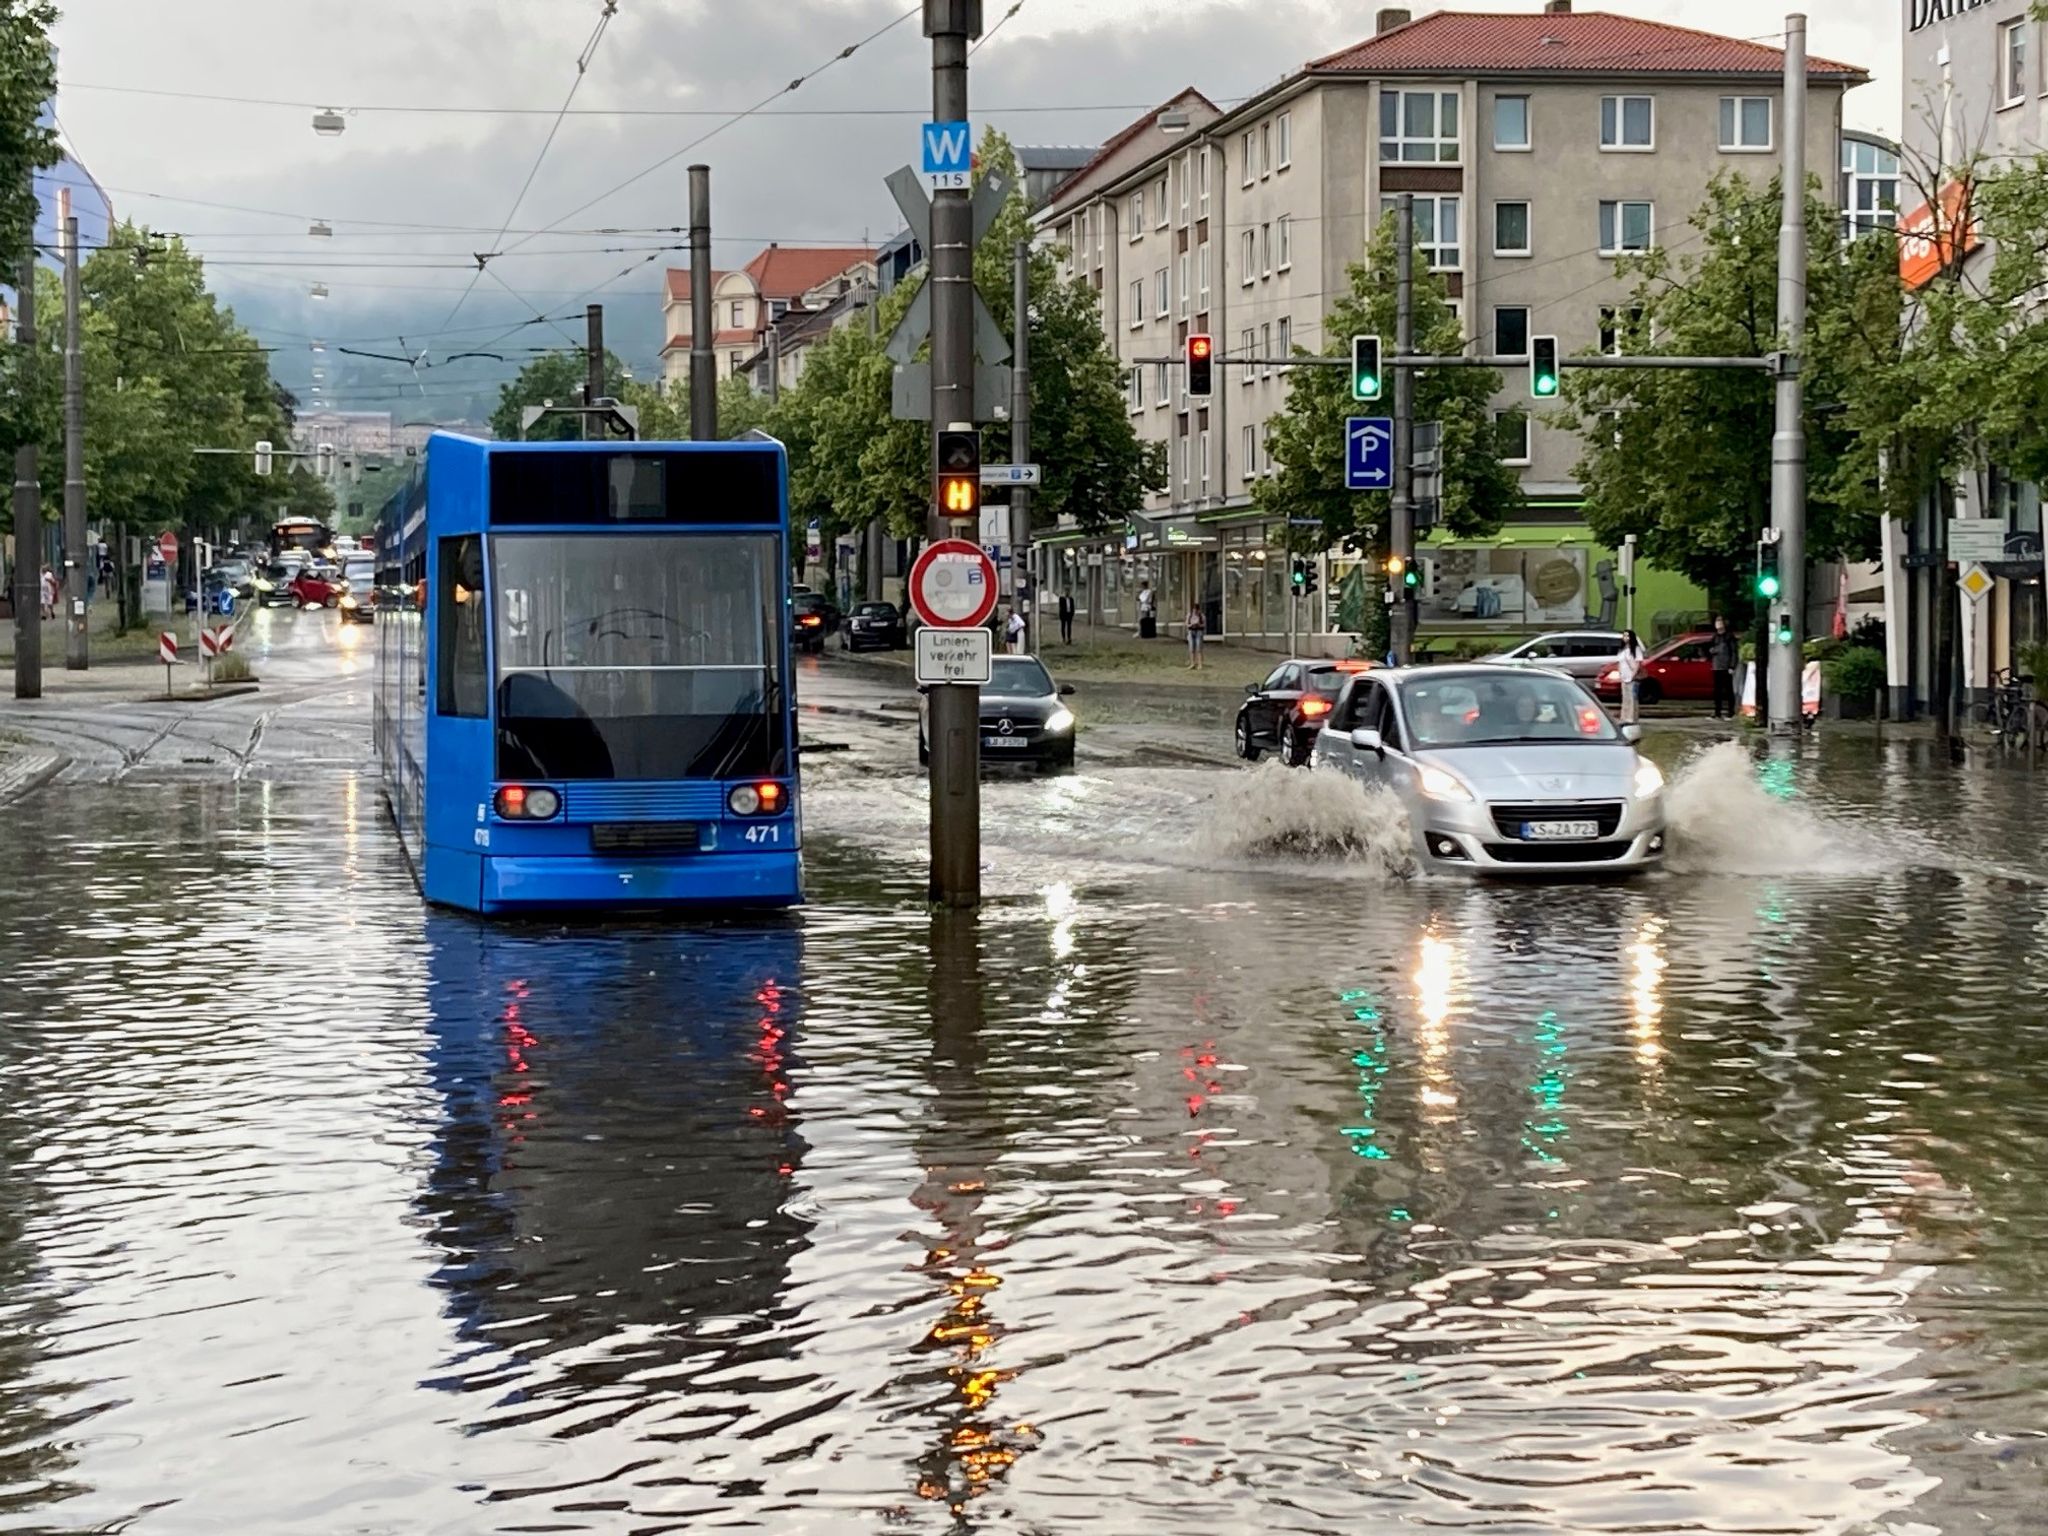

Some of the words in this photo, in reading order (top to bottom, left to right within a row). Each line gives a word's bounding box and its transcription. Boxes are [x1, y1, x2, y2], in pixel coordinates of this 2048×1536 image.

[927, 130, 966, 164] W
[931, 174, 963, 186] 115
[1361, 436, 1379, 463] P
[944, 663, 965, 676] frei
[744, 825, 780, 843] 471
